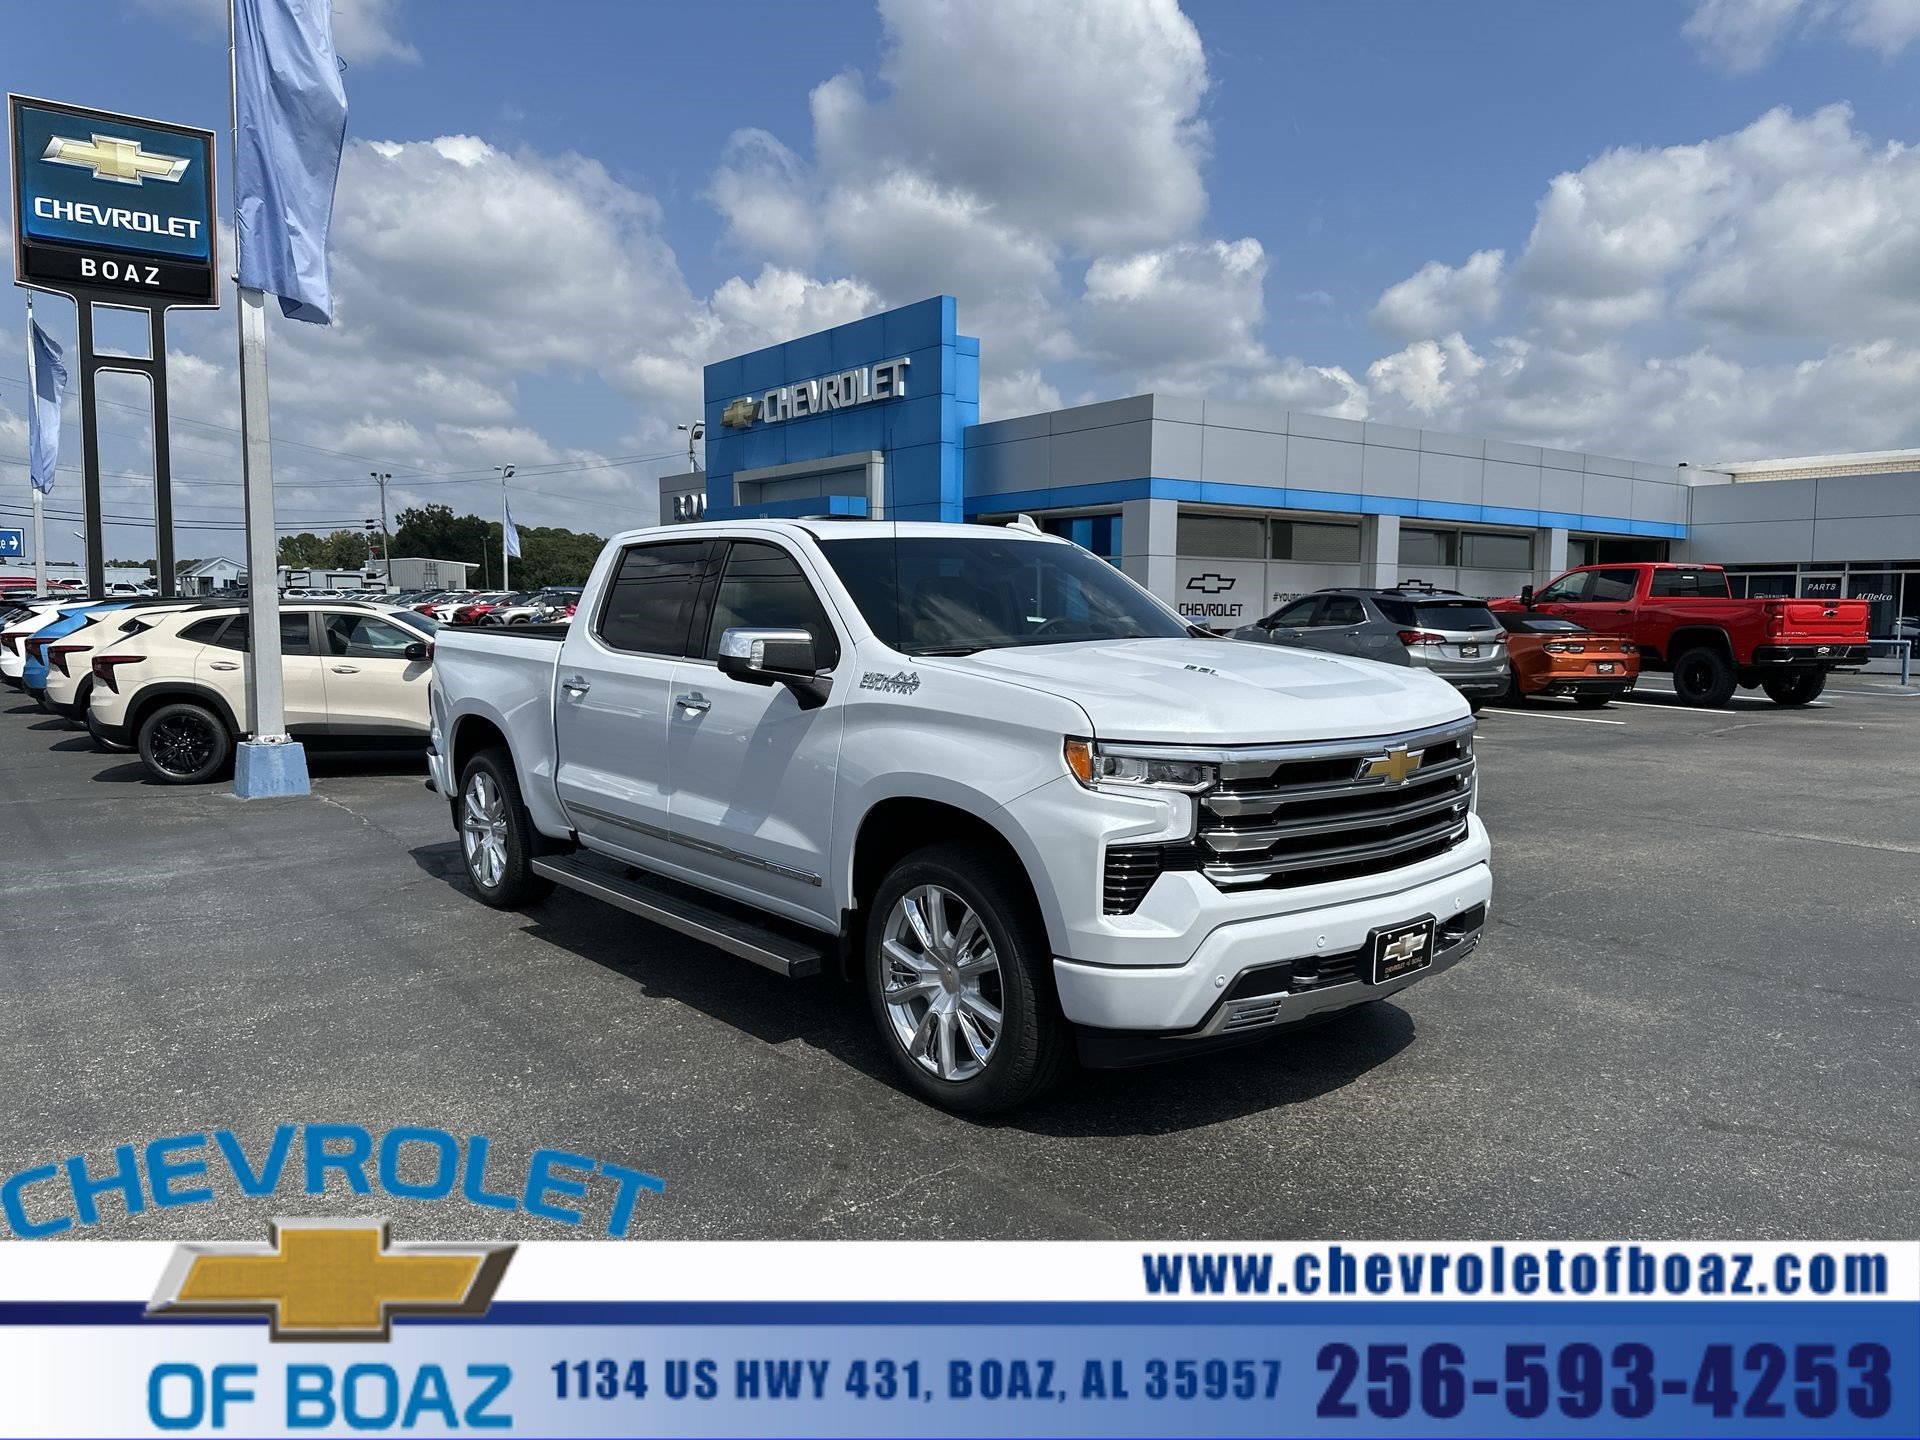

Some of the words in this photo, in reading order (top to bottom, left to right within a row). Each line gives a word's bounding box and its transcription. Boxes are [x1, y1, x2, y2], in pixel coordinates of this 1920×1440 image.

[34, 197, 201, 239] CHEVROLET
[81, 258, 160, 285] BOAZ
[764, 357, 911, 423] CHEVROLET
[1807, 583, 1836, 591] PARTS
[1855, 592, 1893, 601] ACDelco
[1178, 603, 1243, 617] CHEVROLET
